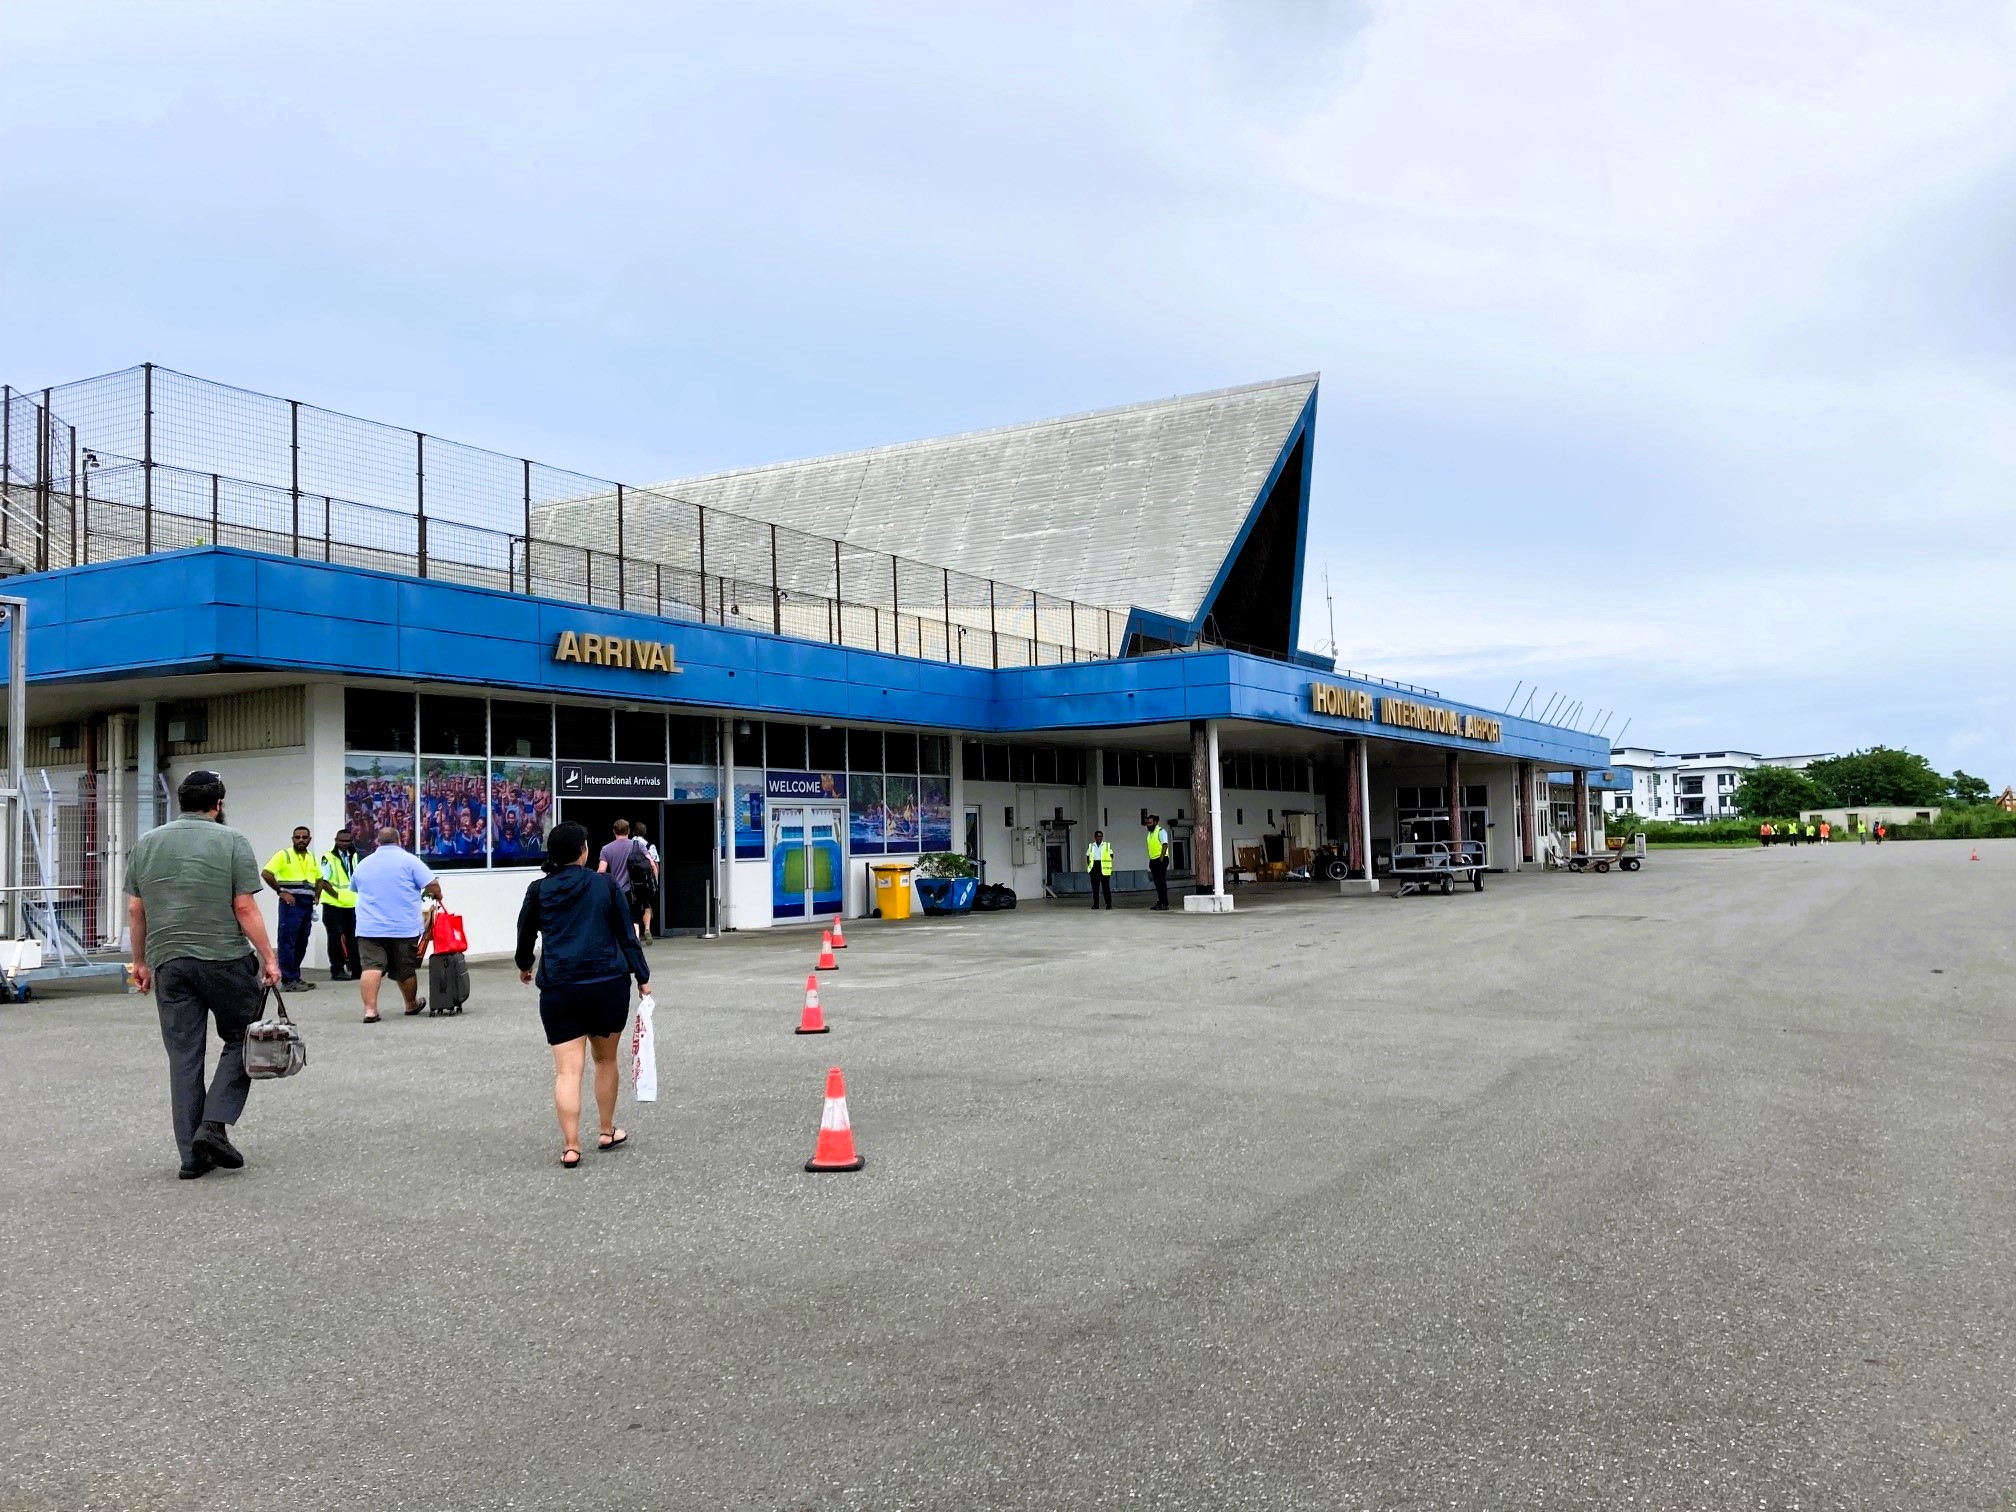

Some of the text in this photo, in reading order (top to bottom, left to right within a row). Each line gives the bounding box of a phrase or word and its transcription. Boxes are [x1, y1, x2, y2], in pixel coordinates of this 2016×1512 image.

[555, 630, 684, 673] ARRIVAL
[1312, 682, 1503, 743] HONIARA INTERNATIONAL AIRPORT
[584, 774, 661, 786] International Arrivals
[768, 780, 821, 793] WELCOME
